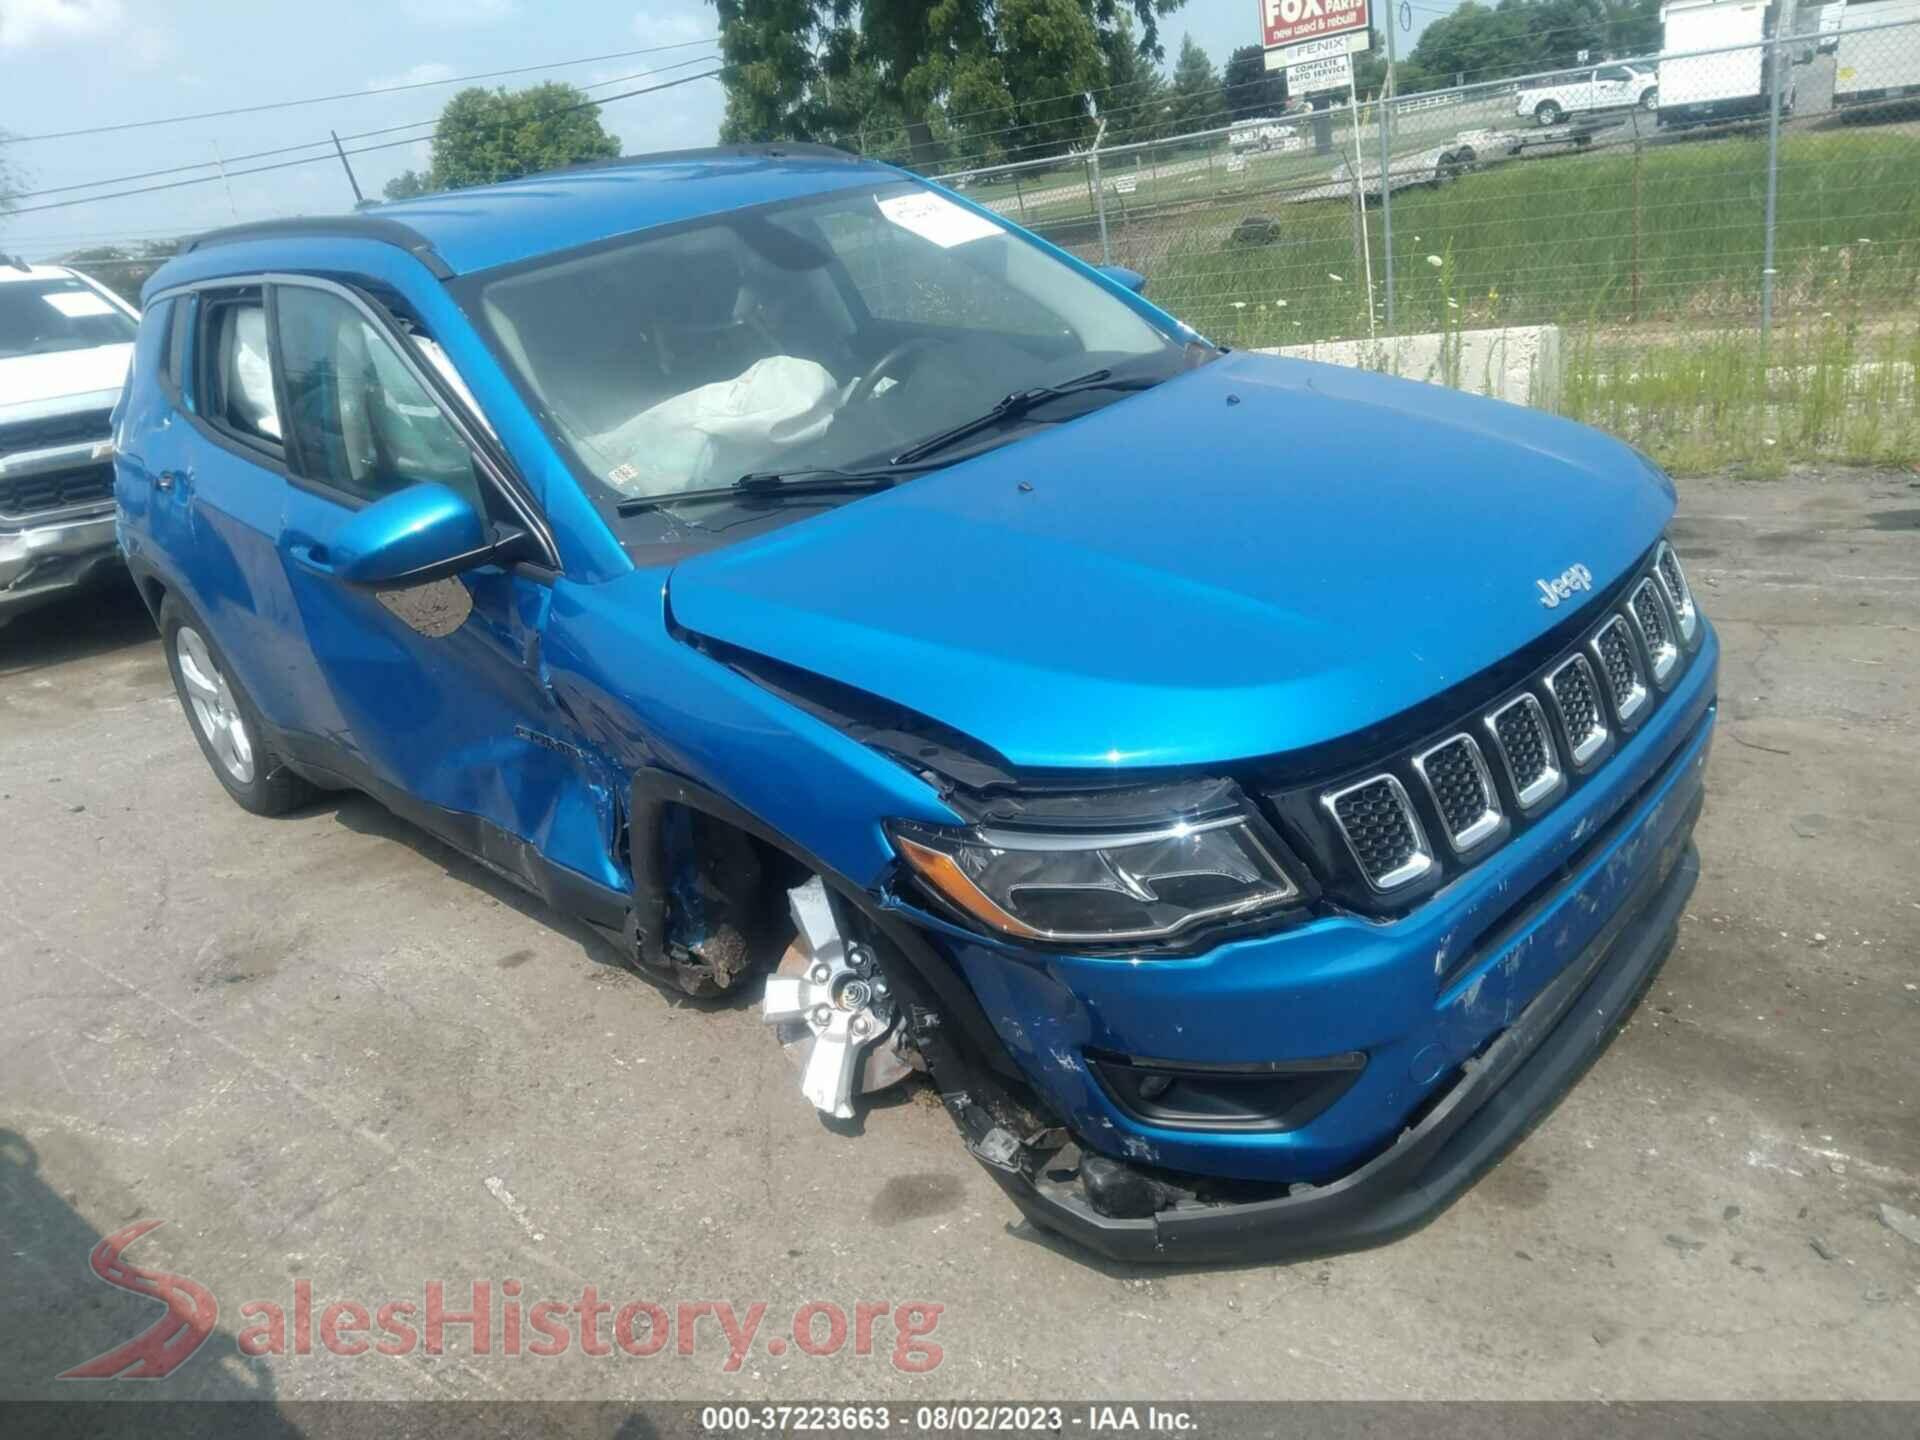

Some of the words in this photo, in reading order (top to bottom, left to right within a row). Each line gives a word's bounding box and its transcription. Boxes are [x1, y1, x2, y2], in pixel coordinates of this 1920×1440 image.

[1265, 0, 1324, 28] FOX
[1273, 27, 1292, 40] new
[1294, 20, 1317, 35] used
[1327, 11, 1358, 28] rebuilt
[1296, 38, 1346, 57] FENIX
[1289, 71, 1311, 83] AUTO
[1313, 65, 1347, 78] SERVICE
[1295, 59, 1338, 74] COMPLETE
[1536, 562, 1592, 608] Jeep
